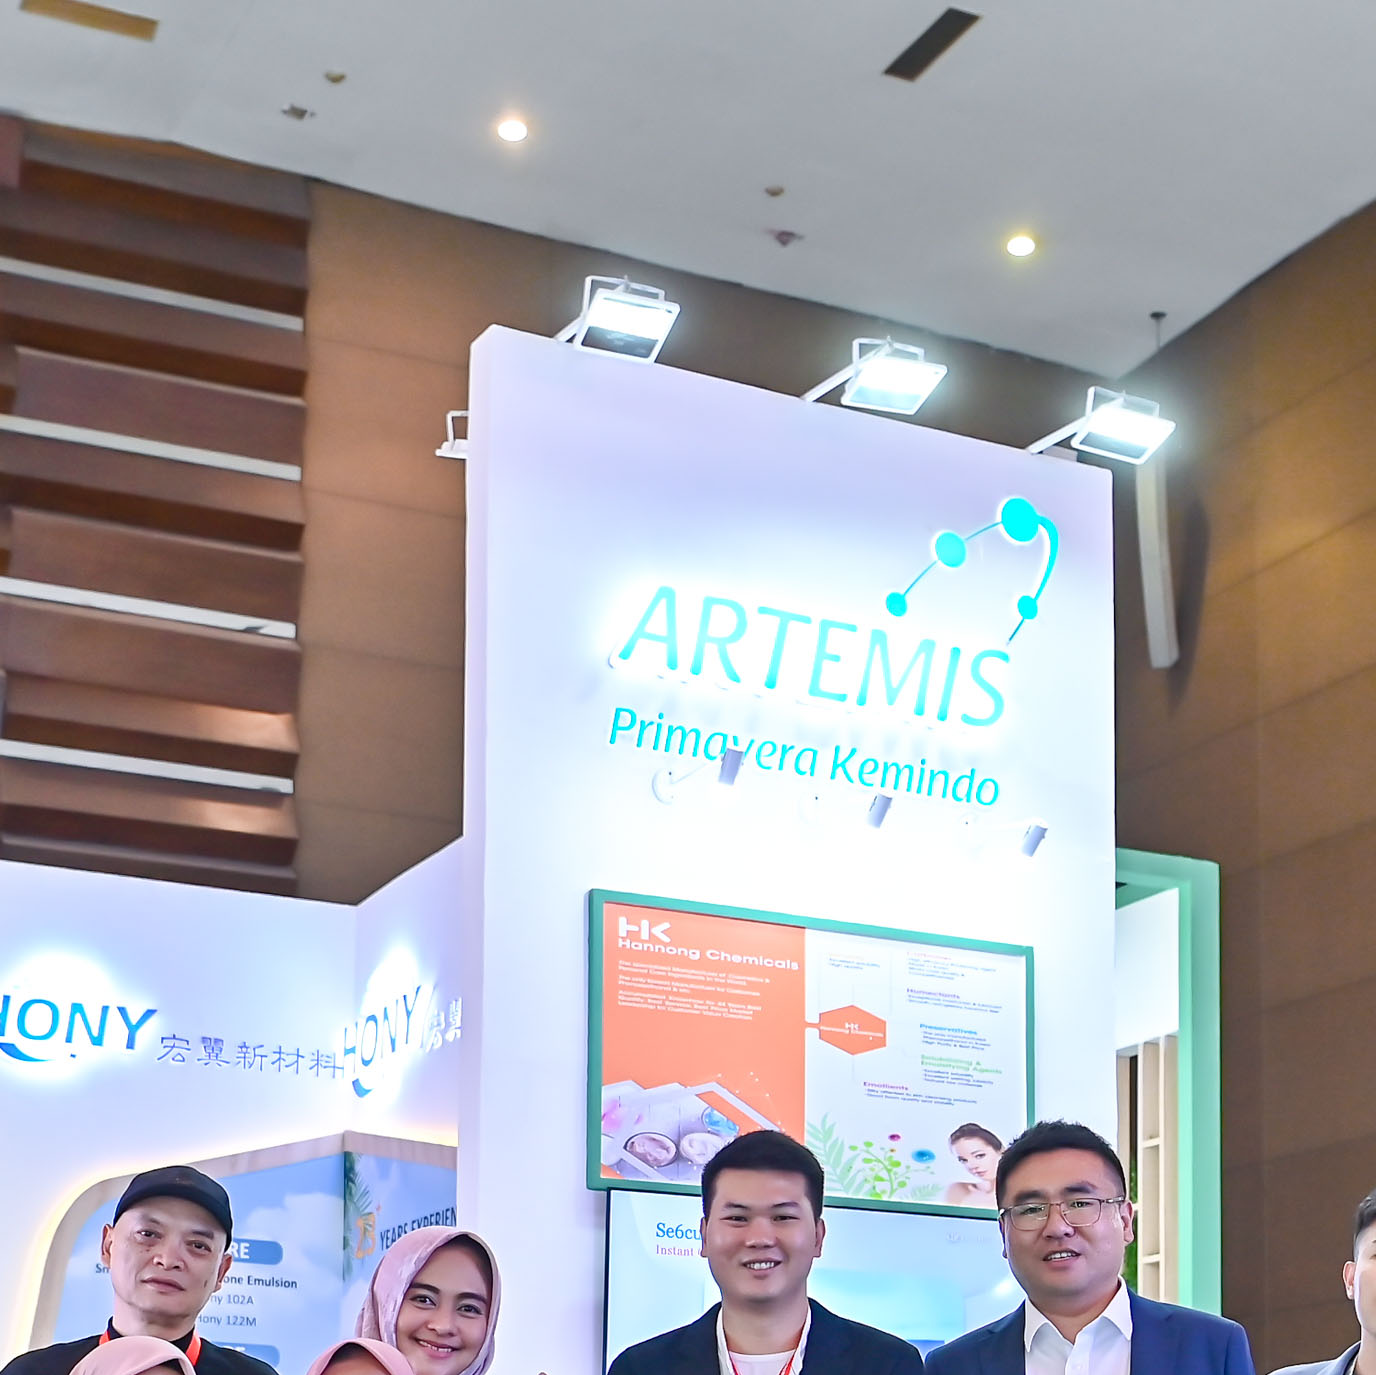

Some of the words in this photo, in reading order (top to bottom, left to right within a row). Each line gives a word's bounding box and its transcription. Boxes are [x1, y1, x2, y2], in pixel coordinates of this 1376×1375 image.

[617, 586, 1011, 727] ARTEMIS
[609, 707, 818, 777] Primavera
[830, 745, 1000, 806] Kemindo
[618, 916, 671, 943] HK
[618, 938, 700, 960] Hannong
[706, 949, 799, 970] Chemicals
[344, 985, 421, 1074] HONY
[226, 1242, 250, 1259] RE
[656, 1245, 694, 1257] Instant
[247, 1274, 297, 1289] Emulsion
[227, 1294, 254, 1305] 102A
[226, 1315, 256, 1327] 122M
